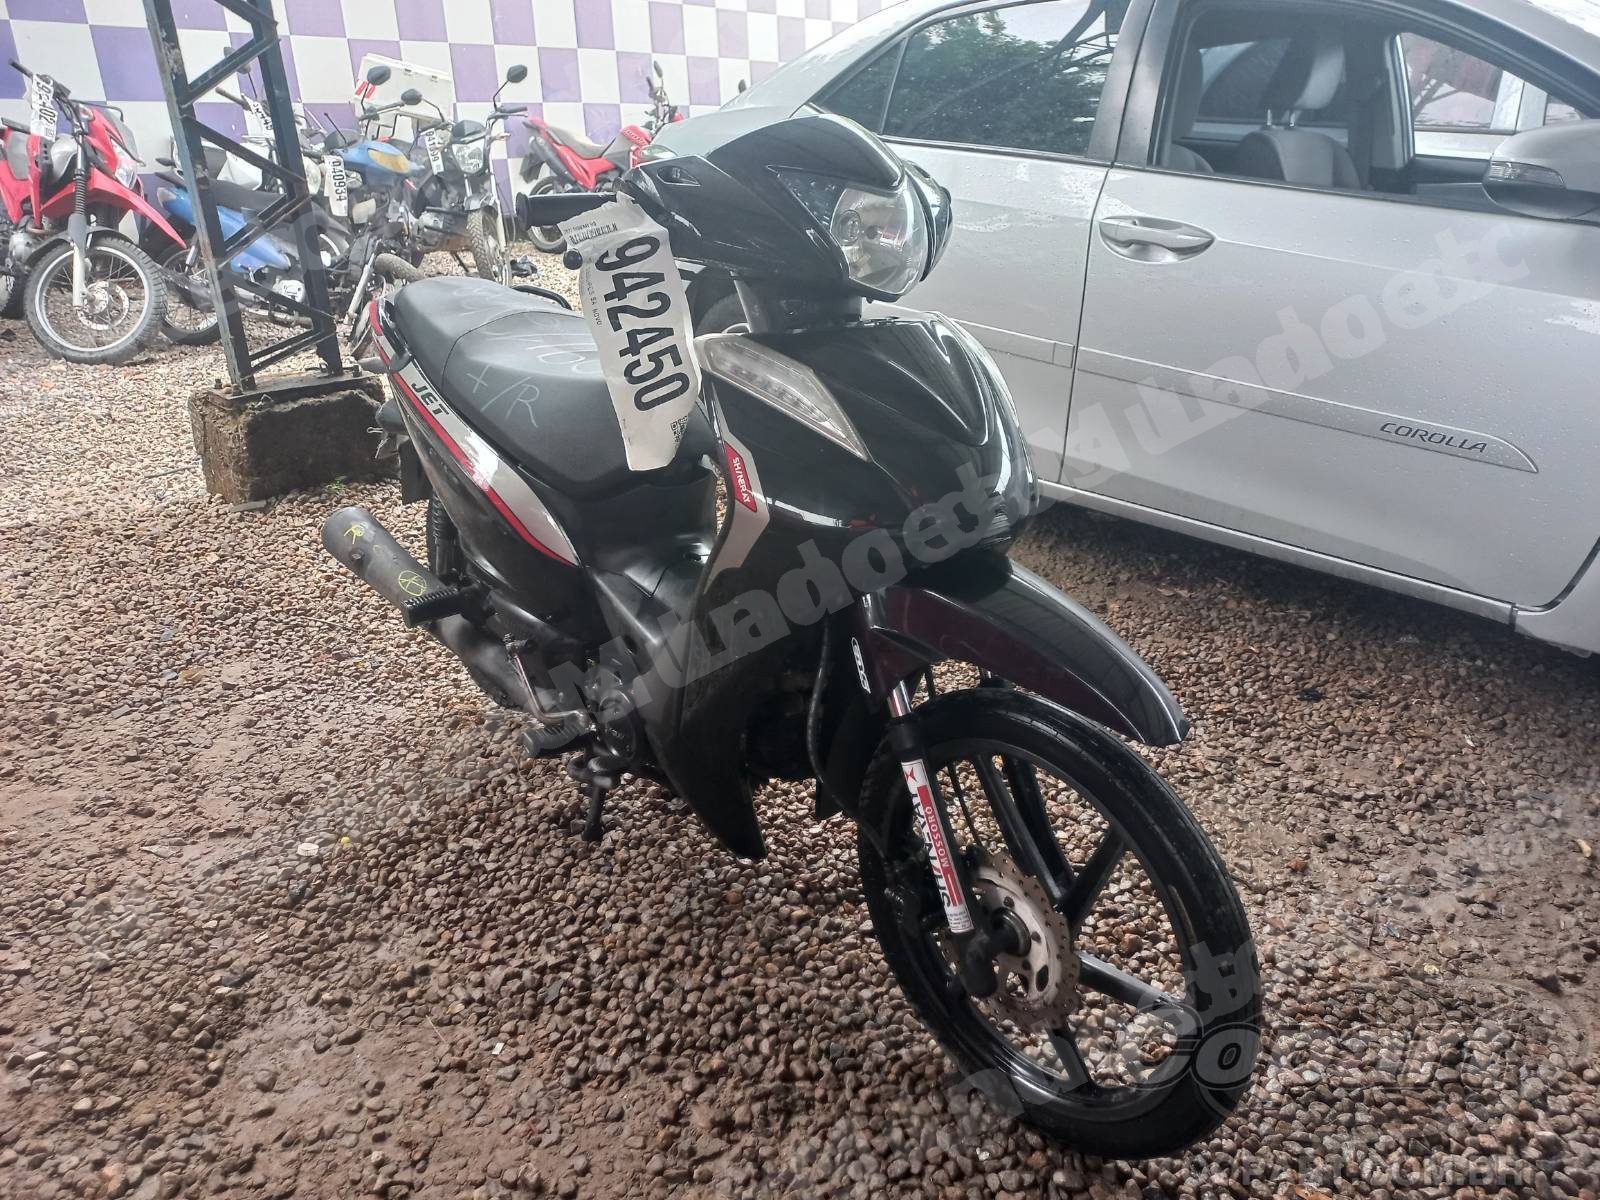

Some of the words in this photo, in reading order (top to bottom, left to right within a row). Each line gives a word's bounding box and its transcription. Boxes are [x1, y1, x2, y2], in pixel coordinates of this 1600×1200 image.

[594, 235, 690, 412] 942450
[410, 382, 450, 416] JET
[1380, 422, 1488, 453] COROLLA
[732, 456, 752, 504] SHINERAY
[924, 805, 951, 868] MOSSORO
